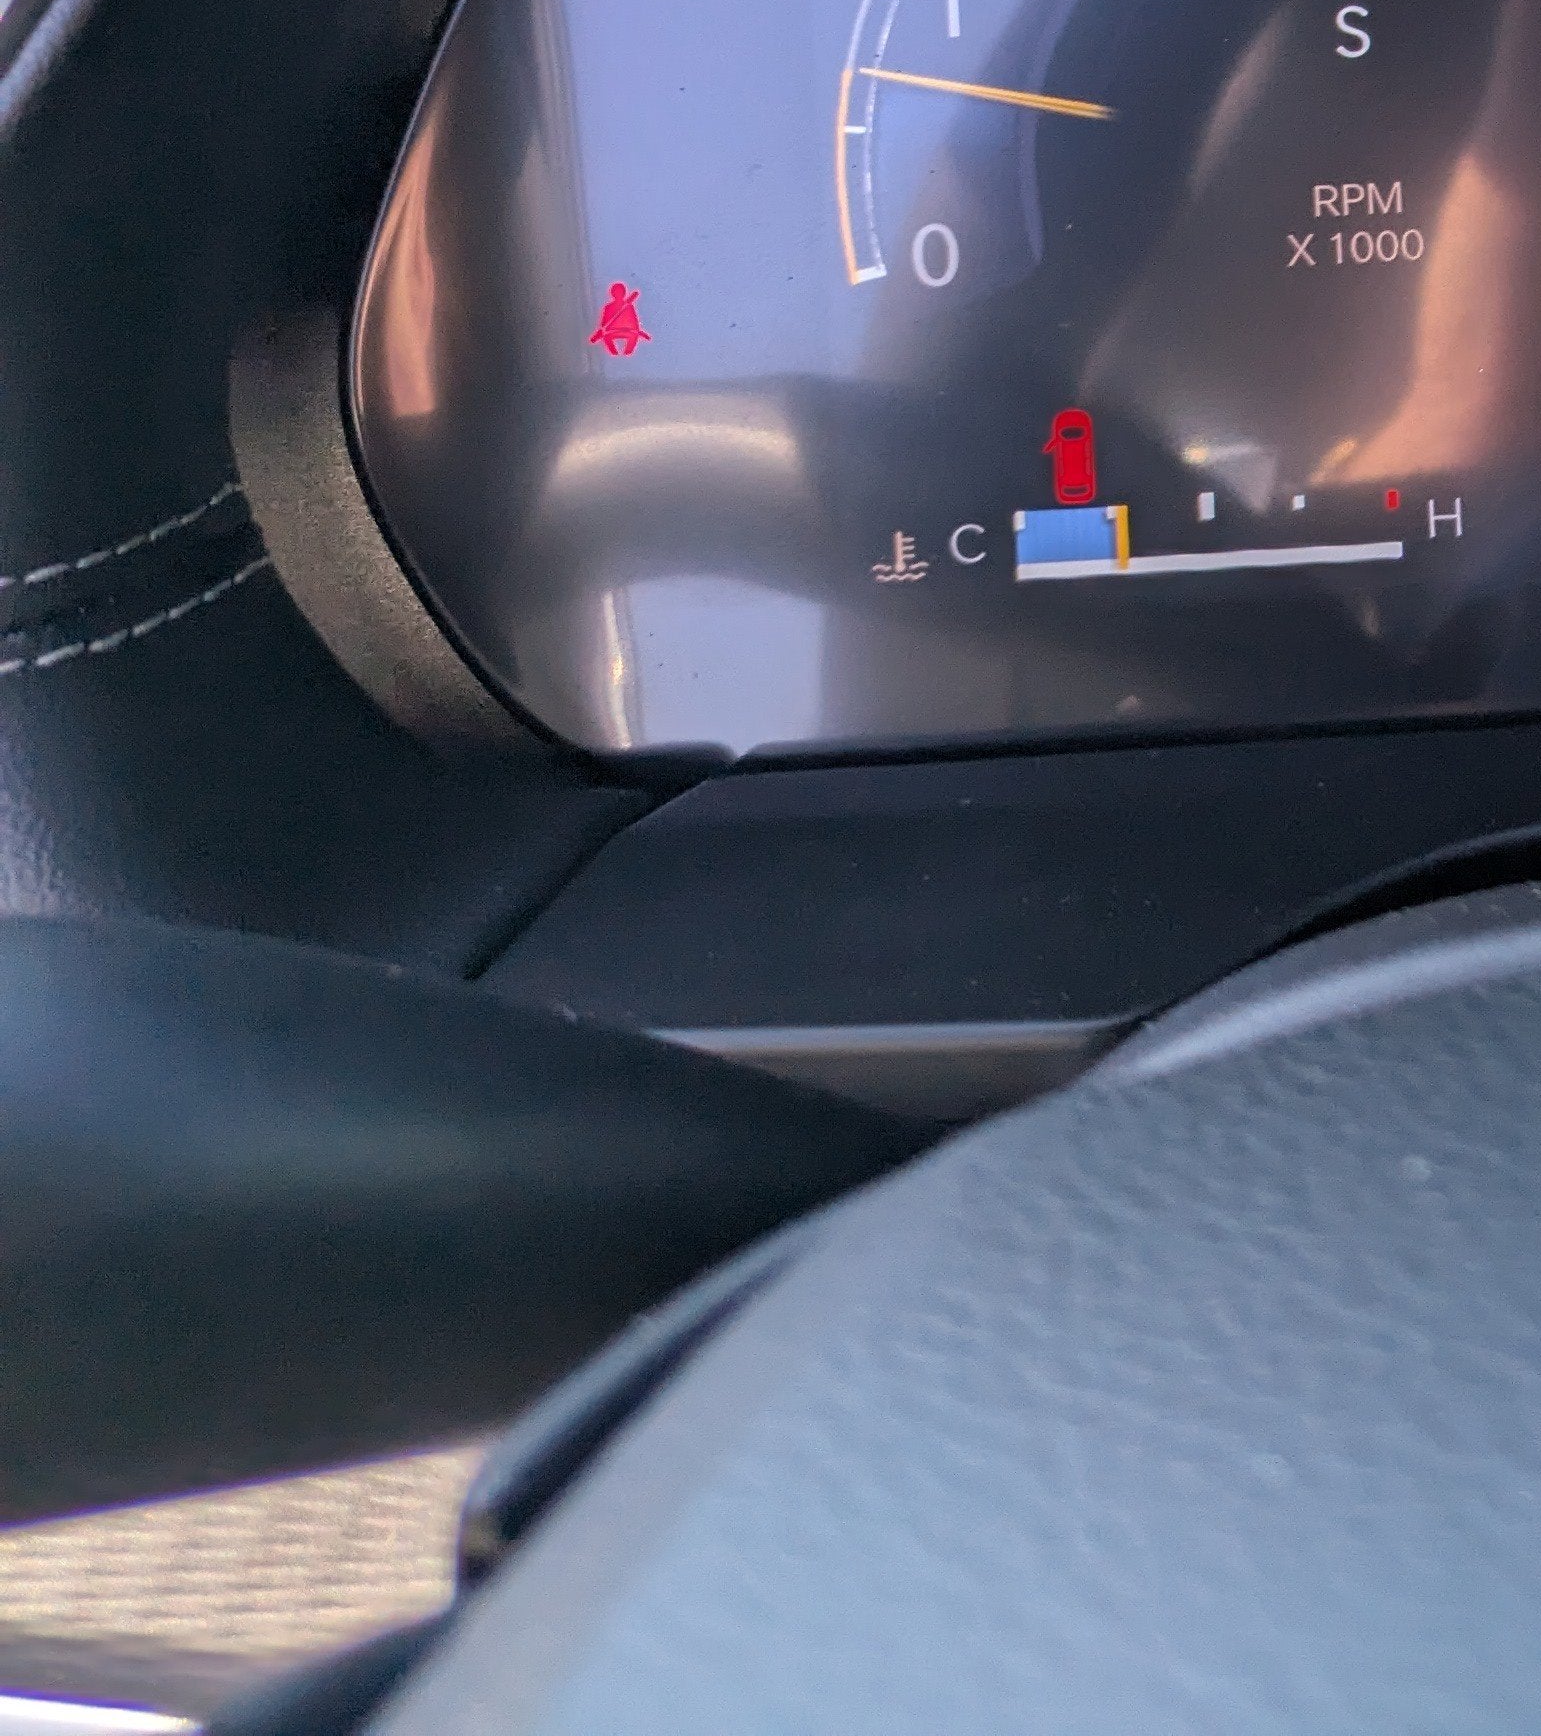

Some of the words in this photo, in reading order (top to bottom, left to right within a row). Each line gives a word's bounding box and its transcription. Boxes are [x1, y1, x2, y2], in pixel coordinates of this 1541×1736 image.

[1334, 5, 1371, 60] S
[1311, 183, 1403, 217] RPM
[910, 223, 961, 287] 0
[1286, 235, 1316, 267] X
[1327, 230, 1425, 264] 1000
[1428, 497, 1463, 540] H
[948, 523, 987, 565] C
